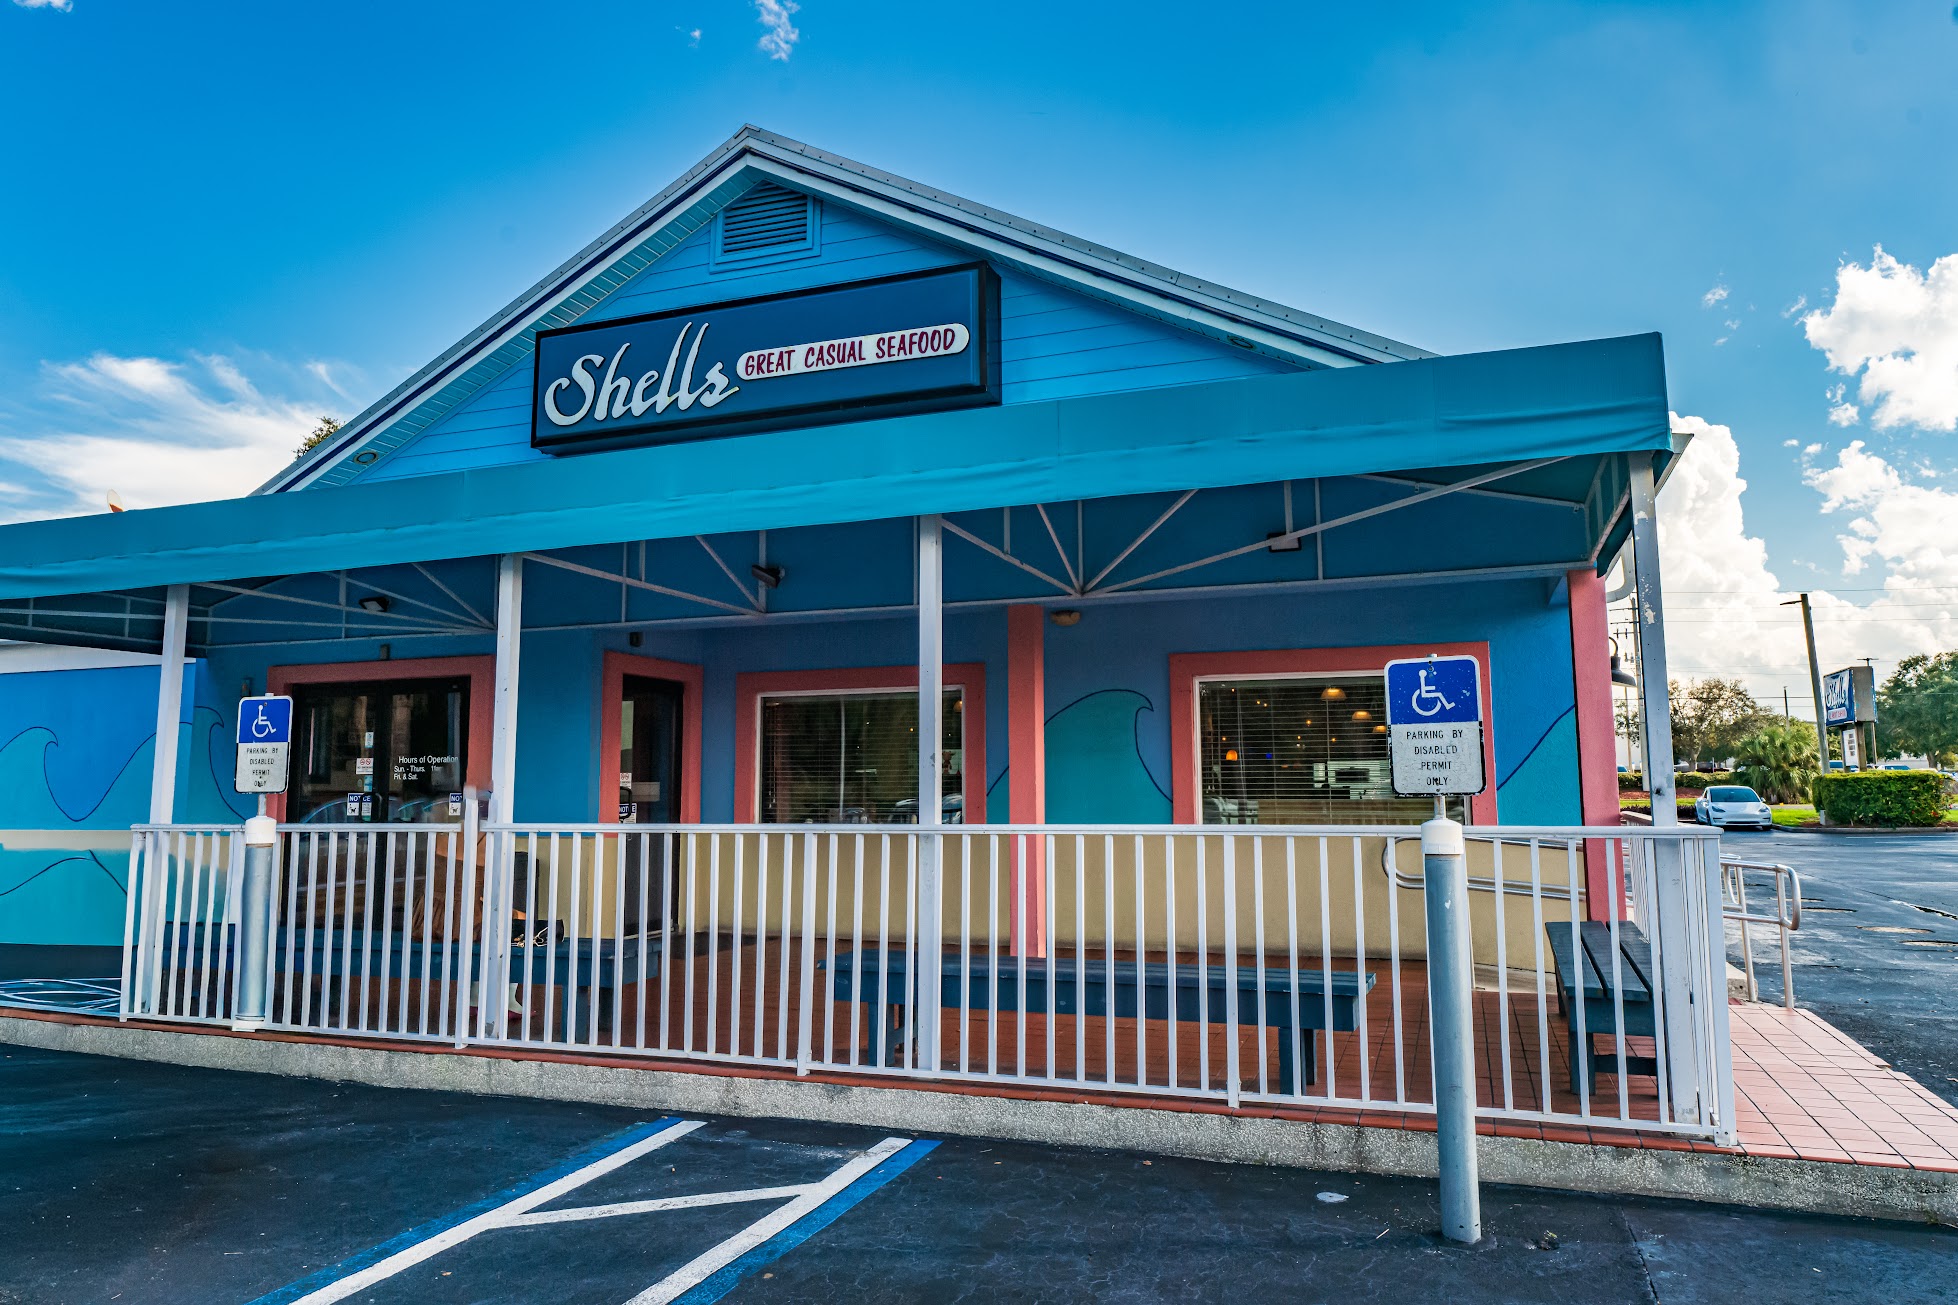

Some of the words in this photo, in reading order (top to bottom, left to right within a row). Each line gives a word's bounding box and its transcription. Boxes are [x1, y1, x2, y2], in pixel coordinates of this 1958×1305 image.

[745, 349, 796, 377] GREAT
[804, 340, 866, 369] CASUAL
[875, 328, 956, 359] SEAFOOD
[544, 321, 740, 426] Shells
[1406, 730, 1444, 740] PARKING
[1452, 729, 1463, 739] BY
[1414, 745, 1458, 755] DISABLED
[398, 756, 418, 764] Hours
[419, 755, 426, 764] of
[427, 755, 459, 765] Operation
[1421, 761, 1452, 771] PERMIT
[1426, 777, 1448, 786] ONLY
